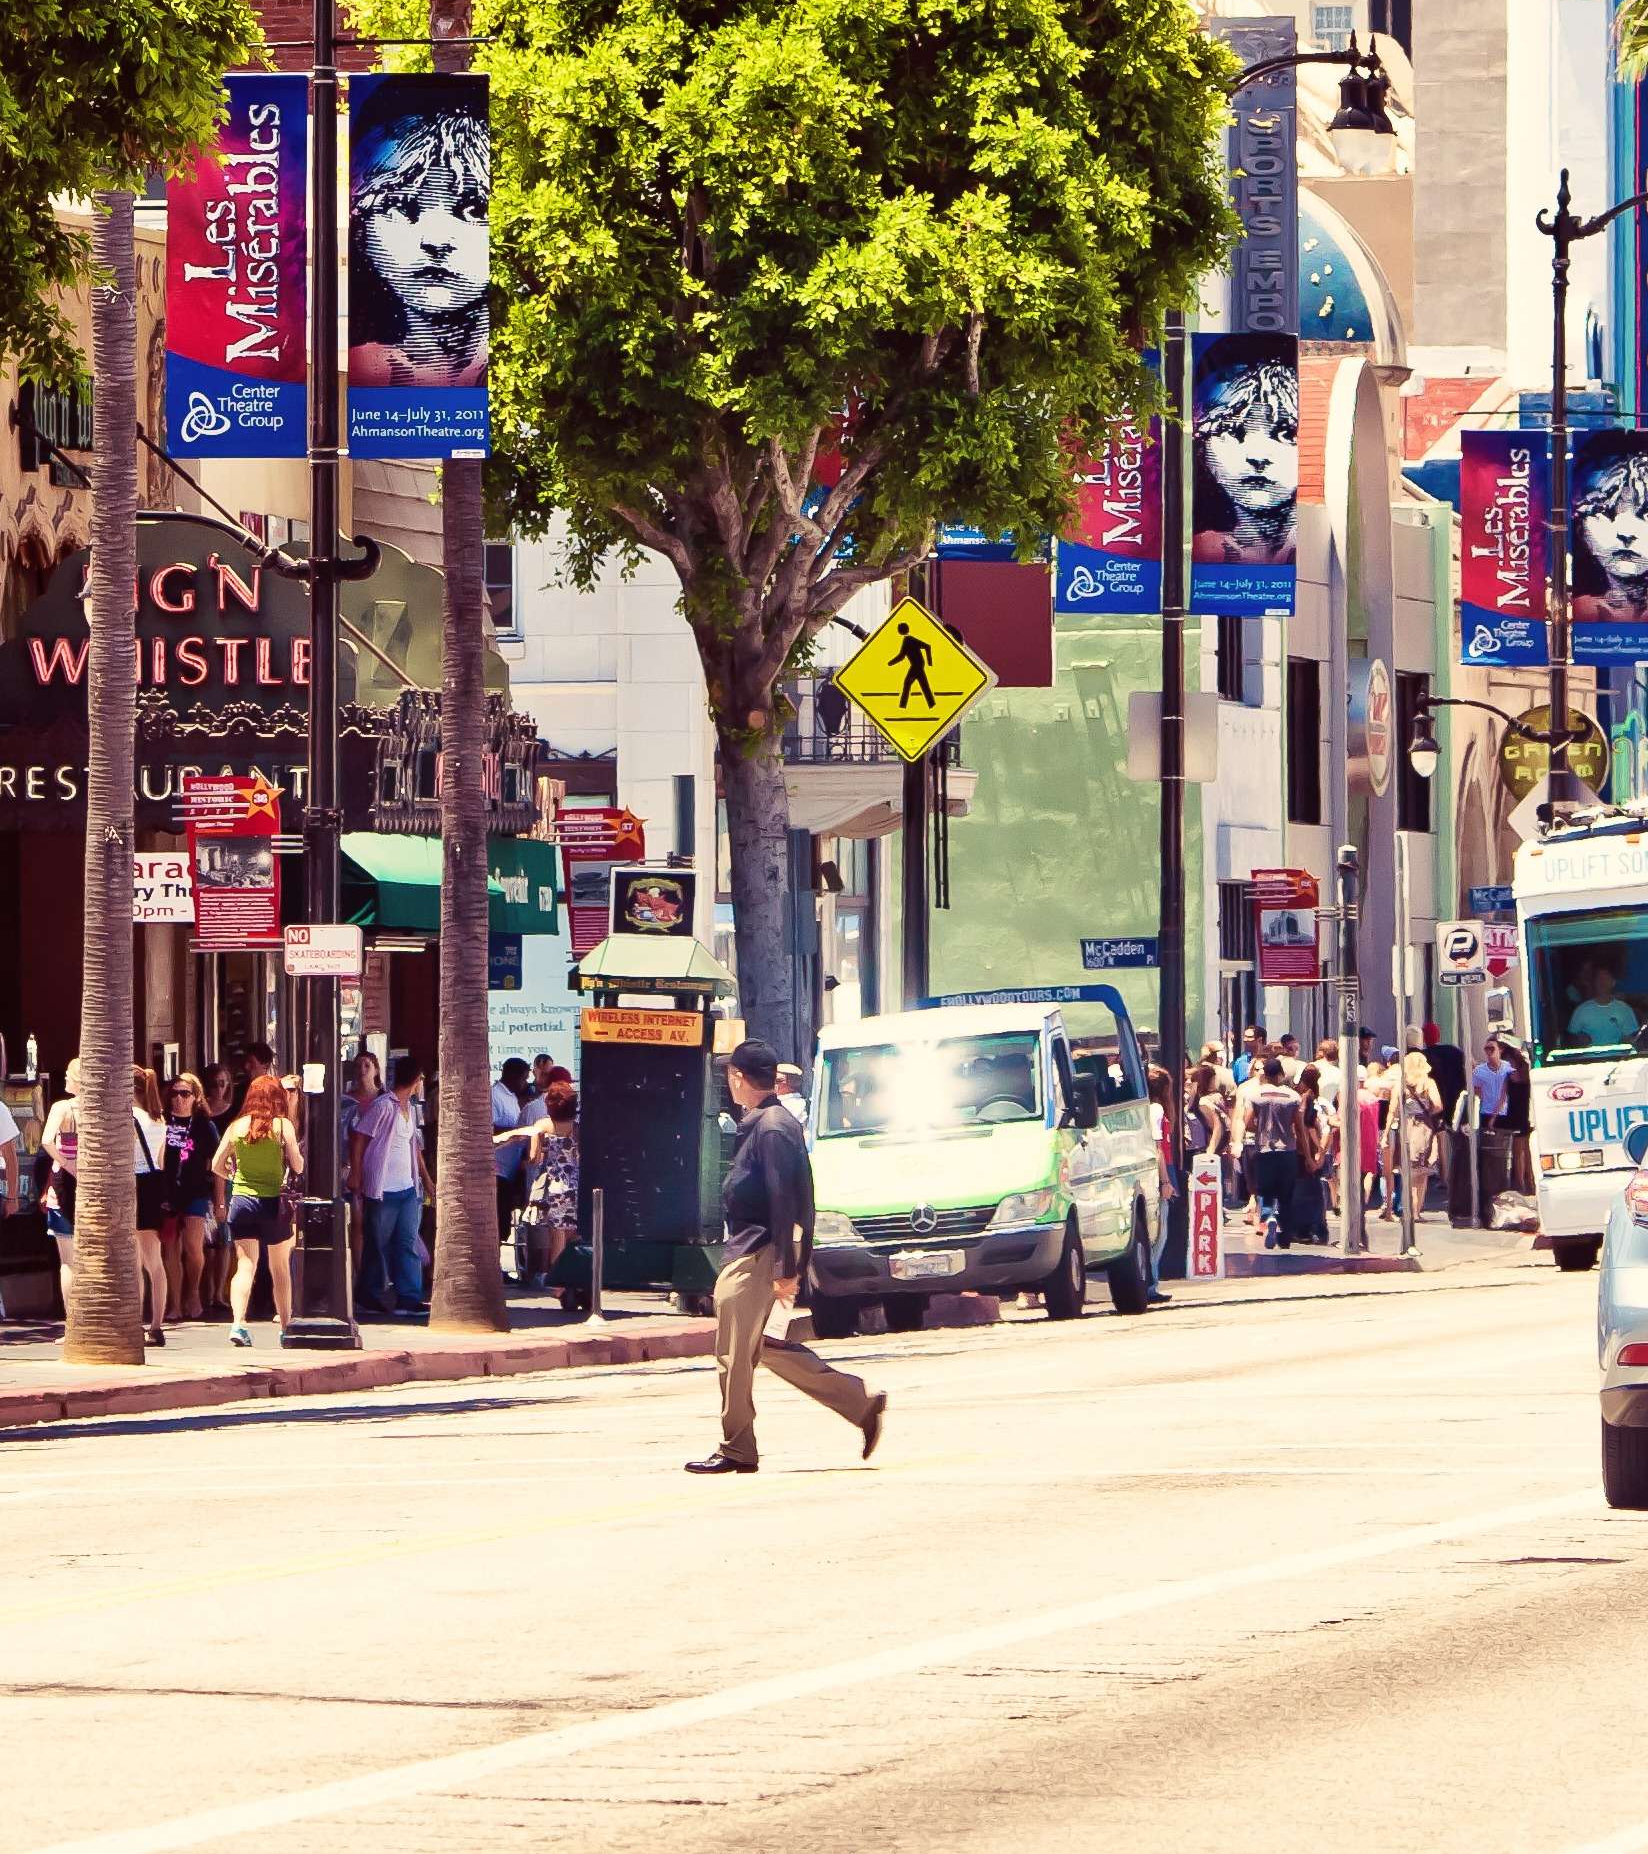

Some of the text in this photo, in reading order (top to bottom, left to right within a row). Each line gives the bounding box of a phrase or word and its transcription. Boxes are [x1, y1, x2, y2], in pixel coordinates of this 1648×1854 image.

[225, 102, 282, 363] Misérables
[185, 199, 236, 284] Les
[231, 382, 281, 400] Center
[216, 397, 274, 414] Theatre
[237, 412, 284, 431] Group
[351, 407, 382, 425] June
[455, 408, 485, 422] 2011
[351, 423, 486, 442] AhmansonTheatre.org
[1496, 447, 1531, 608] Misérables
[1105, 560, 1142, 572] Center
[1094, 569, 1137, 582] Theatre
[1109, 581, 1145, 594] Group
[1193, 579, 1216, 590] June
[1544, 853, 1612, 884] UPLIFT
[288, 930, 309, 944] NO
[289, 949, 356, 960] SKATEBOARDING
[1085, 941, 1145, 956] McCadden
[588, 1010, 697, 1026] WIRELESS INTERNET
[616, 1028, 663, 1041] ACCESS
[1198, 1192, 1213, 1274] PARK
